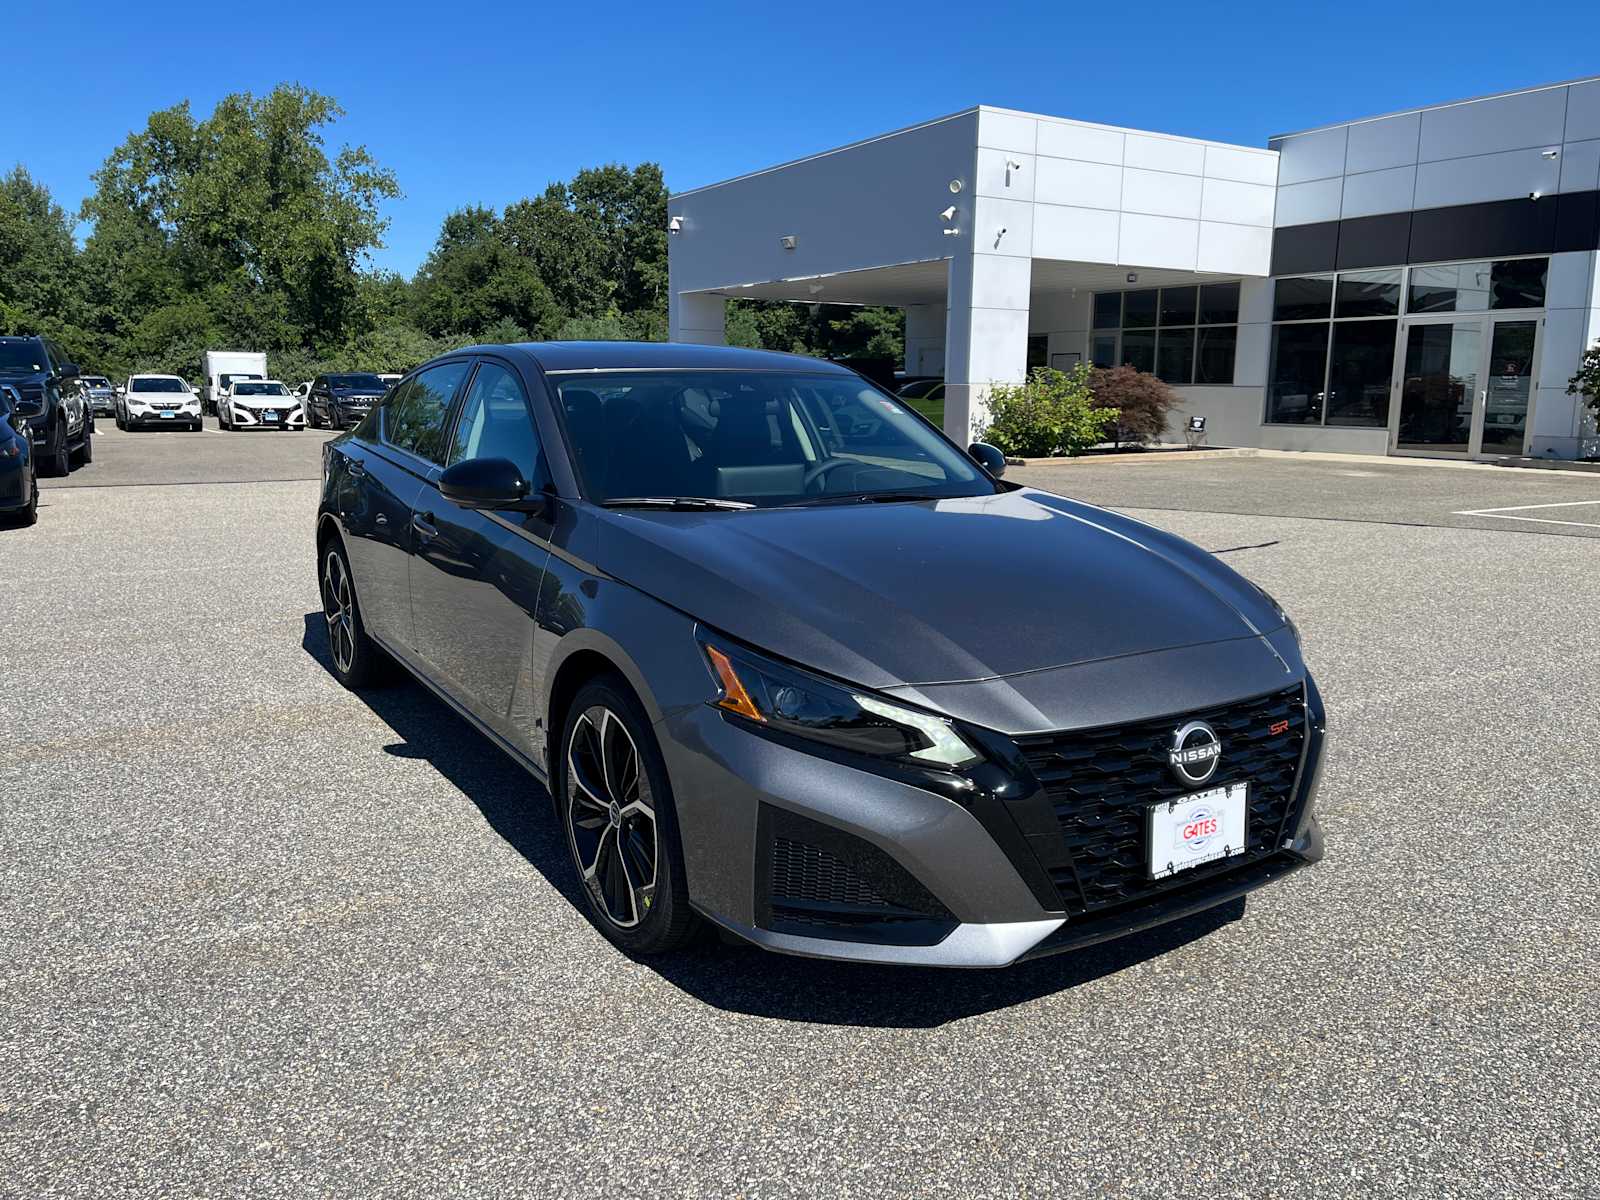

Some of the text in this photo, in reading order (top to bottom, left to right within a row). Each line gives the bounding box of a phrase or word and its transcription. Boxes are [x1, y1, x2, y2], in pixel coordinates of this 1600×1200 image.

[1270, 719, 1289, 736] SR
[1171, 743, 1221, 764] NISSAN
[1183, 819, 1217, 840] GATES
